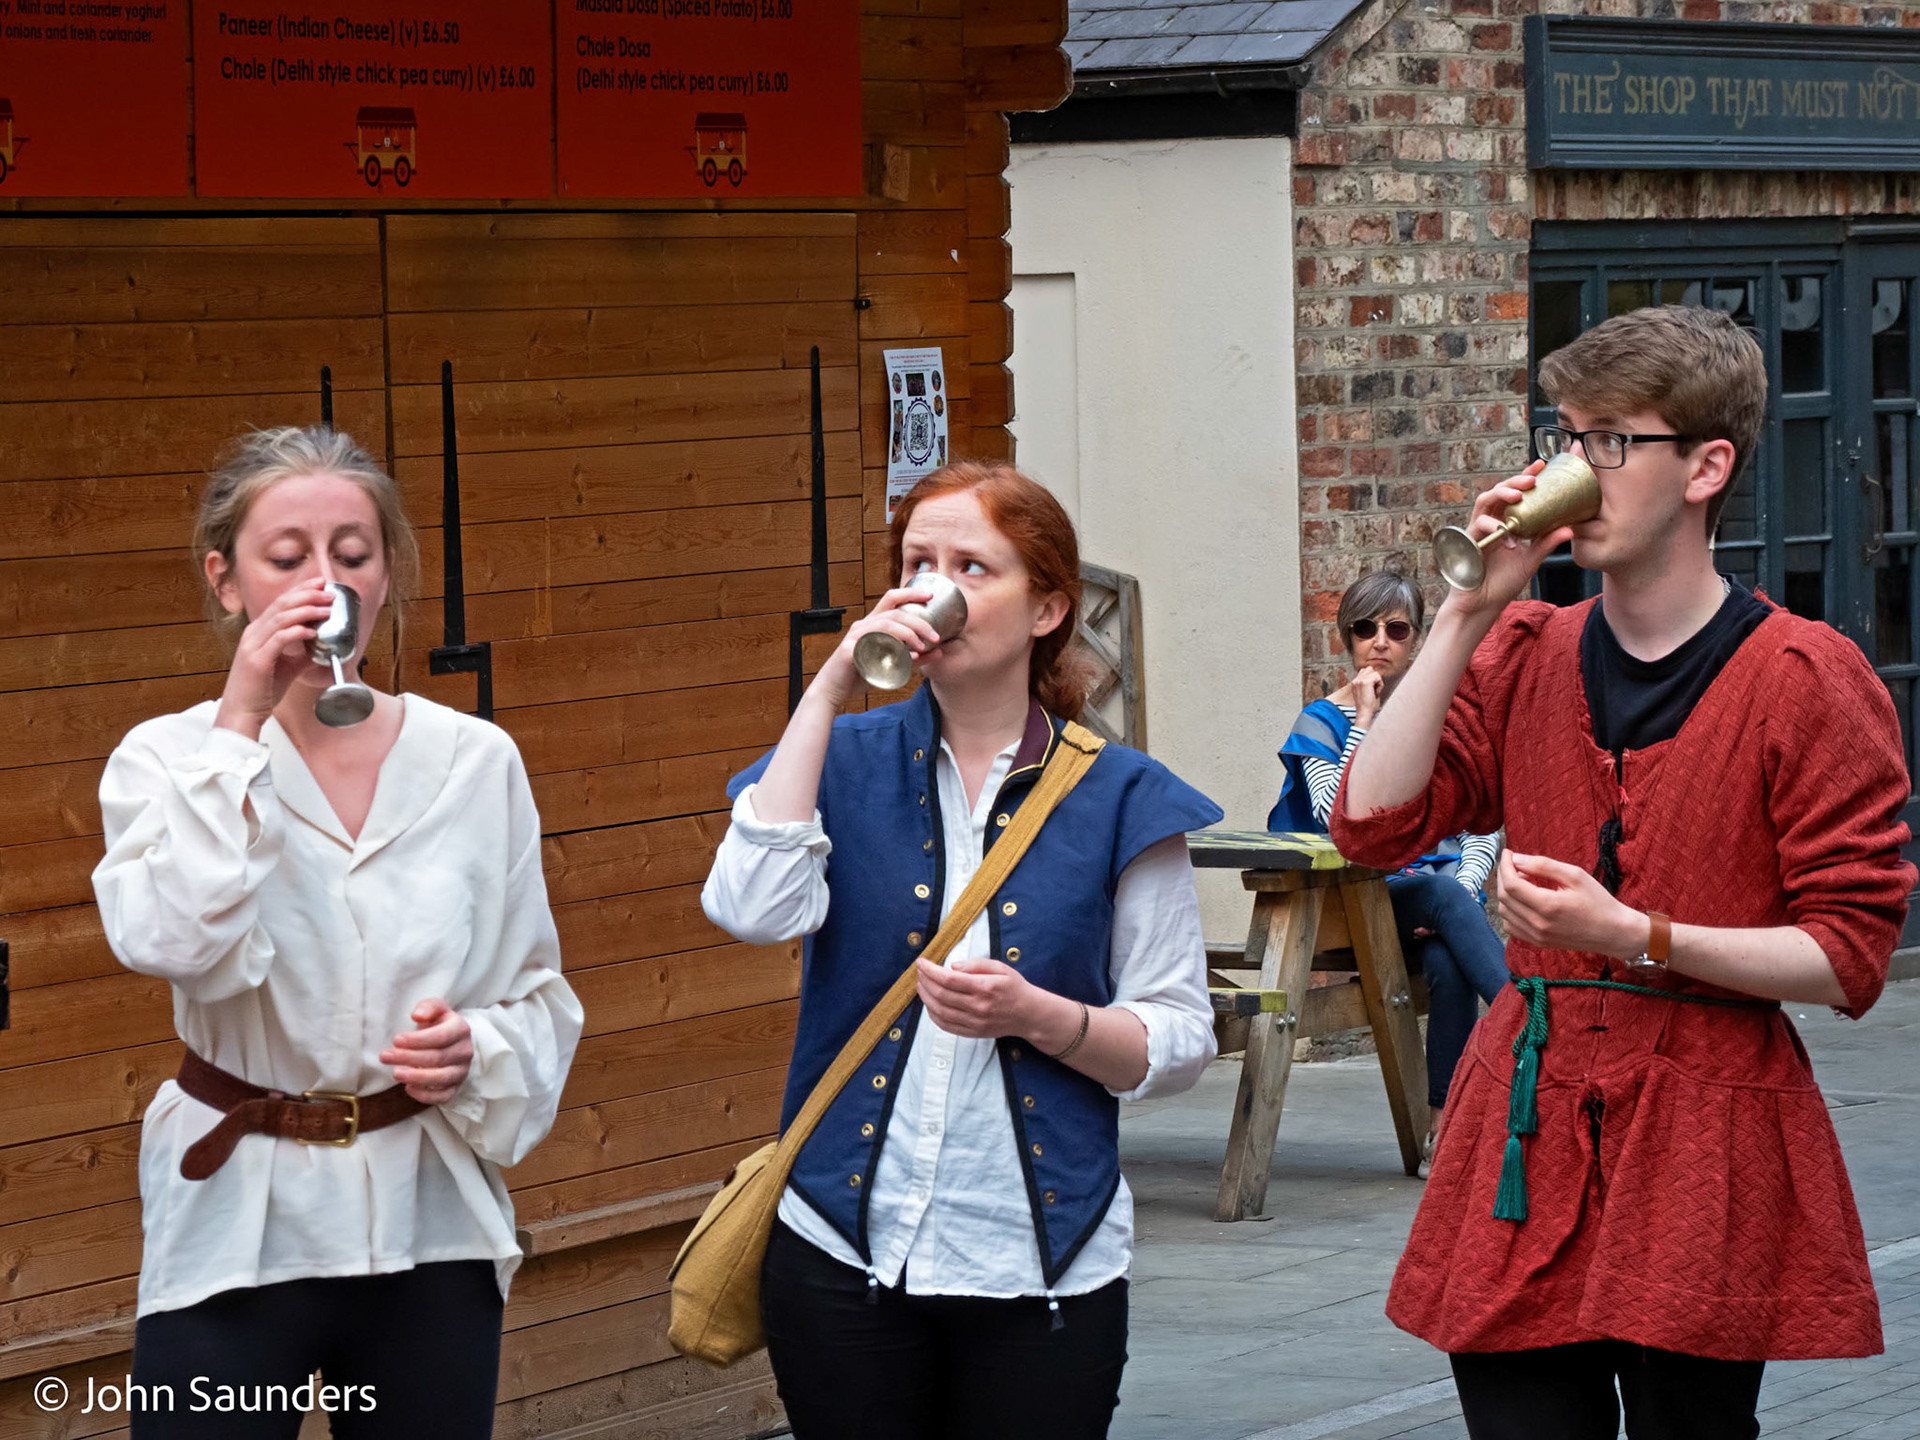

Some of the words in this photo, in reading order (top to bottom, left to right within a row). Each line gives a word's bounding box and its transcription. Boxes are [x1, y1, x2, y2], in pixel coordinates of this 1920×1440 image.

[17, 0, 41, 14] Mint
[43, 0, 66, 15] and
[69, 0, 122, 17] coriander
[125, 2, 167, 22] yoghurt
[576, 0, 624, 13] Masala
[627, 0, 659, 14] Dosa
[662, 0, 710, 19] (Spiced
[714, 0, 757, 22] Potato)
[761, 0, 793, 19] £6.00
[5, 23, 42, 39] onions
[45, 25, 67, 40] and
[70, 24, 96, 41] fresh
[99, 26, 154, 43] coriander.
[219, 12, 273, 36] Paneer
[277, 13, 330, 42] (Indian
[334, 17, 395, 47] Cheese)
[399, 18, 418, 48] (v)
[422, 21, 460, 43] £6.50
[577, 35, 615, 57] Chole
[618, 37, 651, 58] Dosa
[221, 57, 266, 80] Chole
[271, 57, 315, 86] (Delhi
[318, 60, 351, 87] style
[355, 61, 396, 84] chick
[399, 67, 429, 89] pea
[432, 64, 473, 92] curry)
[477, 64, 496, 92] (v)
[499, 66, 535, 88] £6.00
[576, 67, 615, 94] (Delhi
[617, 70, 647, 94] style
[650, 70, 686, 90] chick
[689, 73, 715, 95] pea
[718, 71, 754, 96] curry)
[756, 72, 789, 93] £6.00
[1553, 60, 1621, 114] THE
[1623, 75, 1697, 115] SHOP
[1706, 77, 1772, 129] THAT
[1780, 79, 1849, 118] MUST
[1858, 65, 1907, 120] NOT
